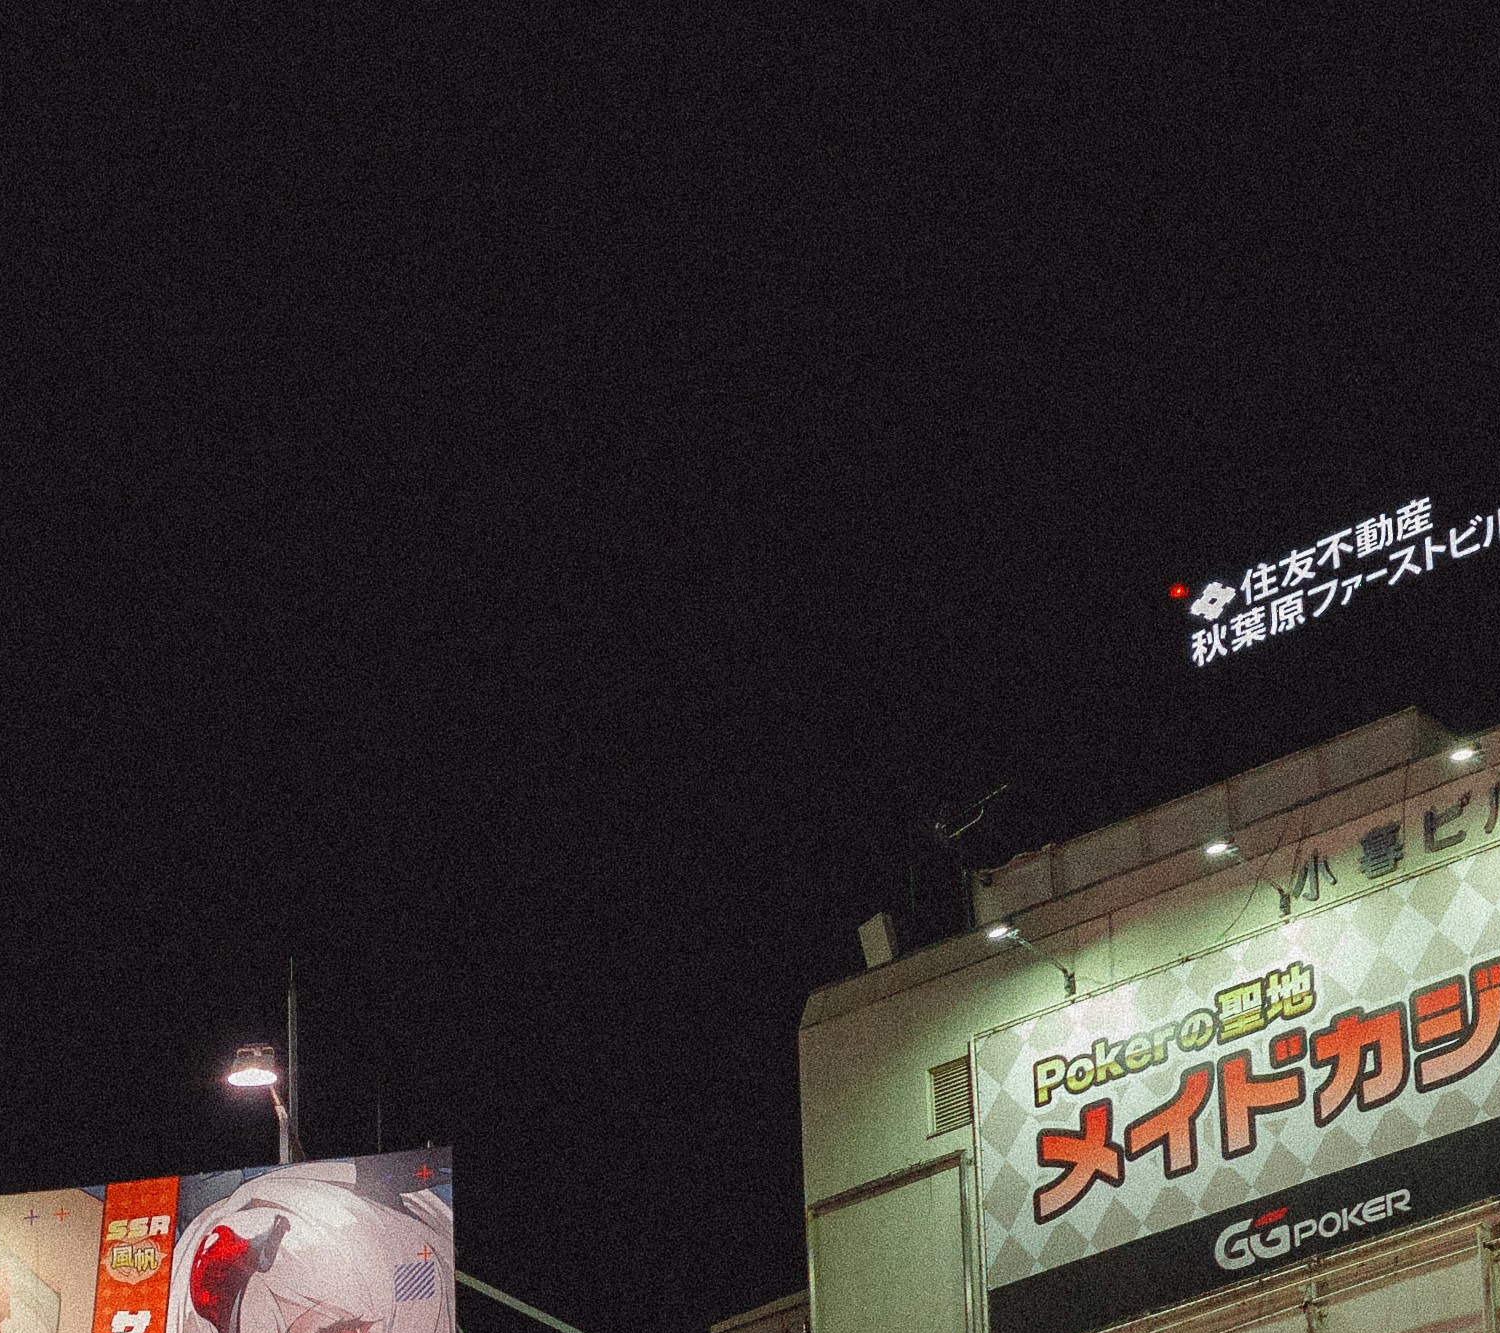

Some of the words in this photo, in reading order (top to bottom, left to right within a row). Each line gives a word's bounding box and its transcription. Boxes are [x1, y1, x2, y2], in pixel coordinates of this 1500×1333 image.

[1240, 497, 1434, 607] 住友不動産
[1035, 961, 1317, 1104] Pokerの聖地
[106, 1214, 171, 1241] SSR
[110, 1245, 159, 1271] 風帆
